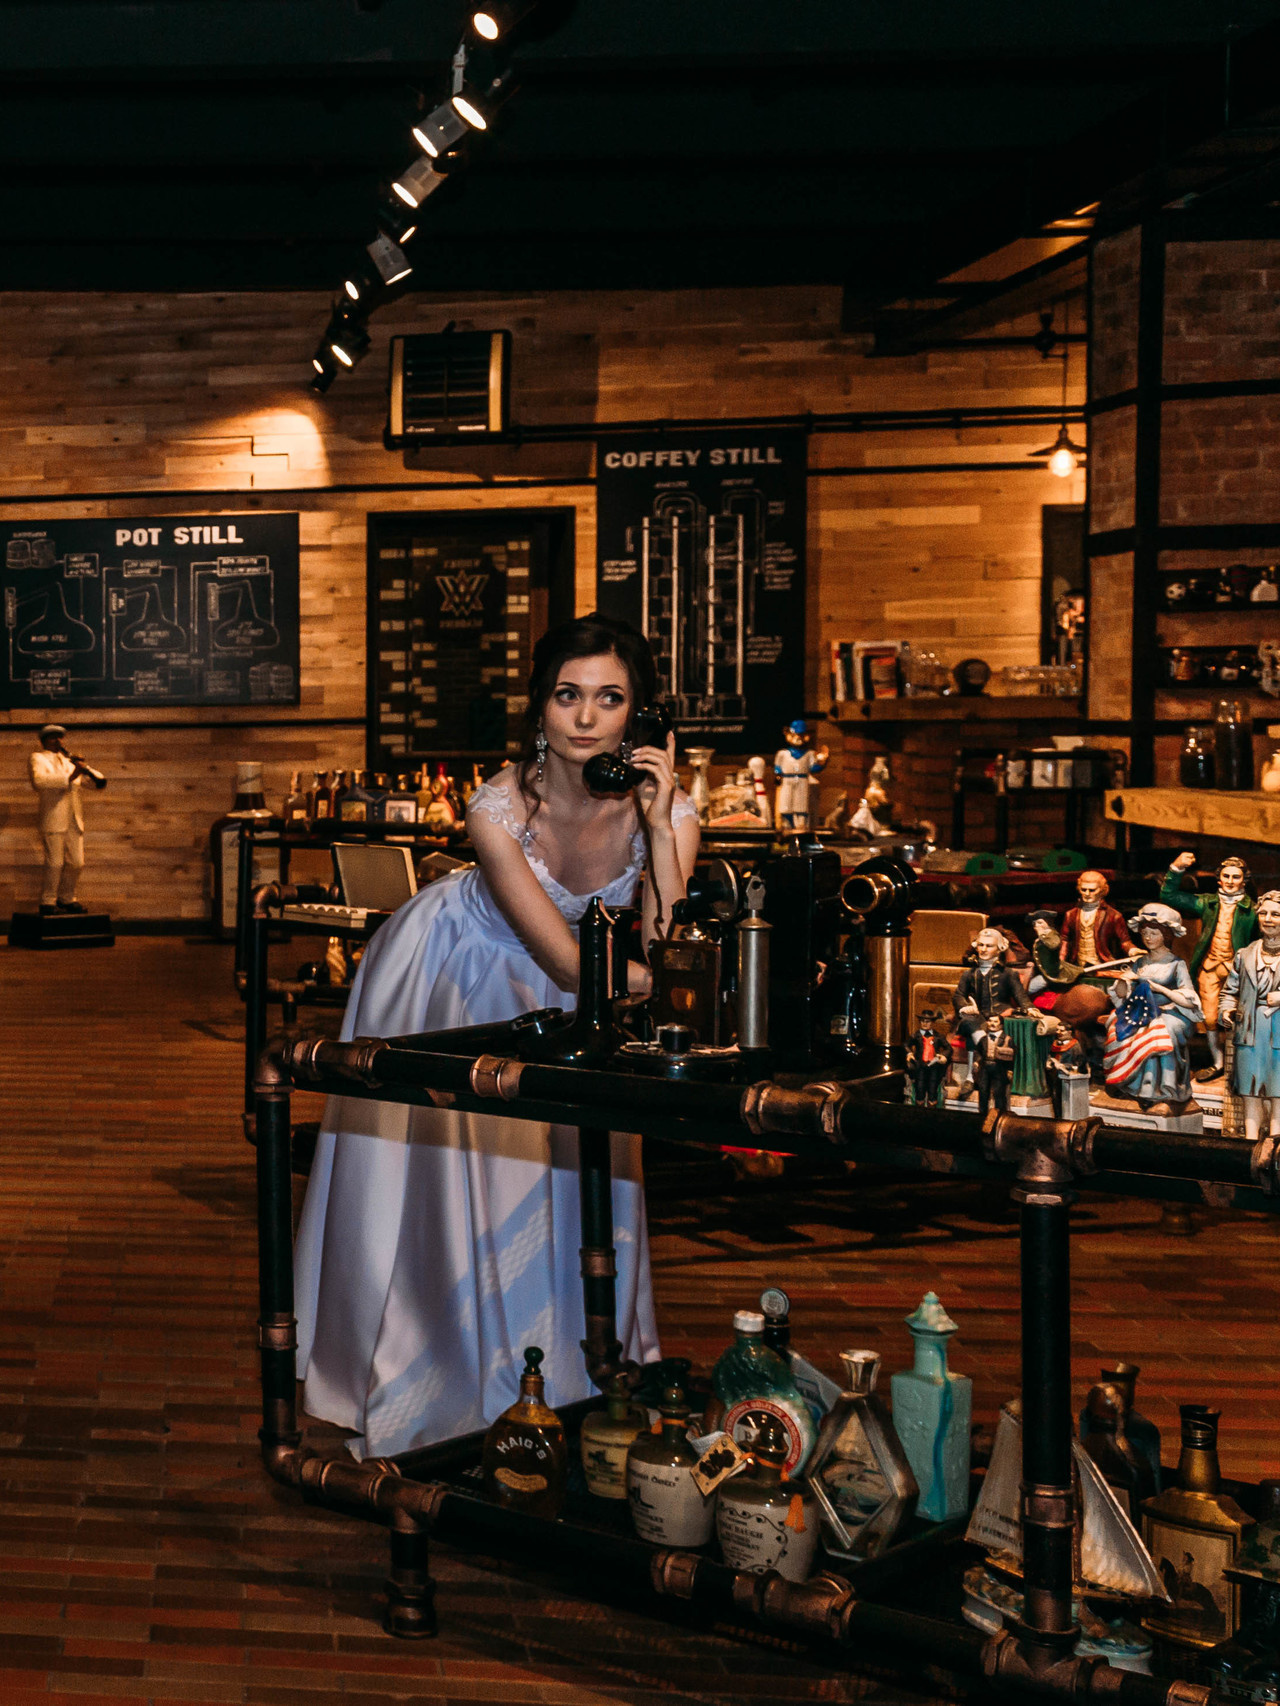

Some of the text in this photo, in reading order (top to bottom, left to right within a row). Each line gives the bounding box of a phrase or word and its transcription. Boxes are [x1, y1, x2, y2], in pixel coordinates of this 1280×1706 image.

[604, 446, 782, 468] COFFEY STILL
[116, 525, 243, 546] POT STILL
[496, 1436, 548, 1460] HAIG'S
